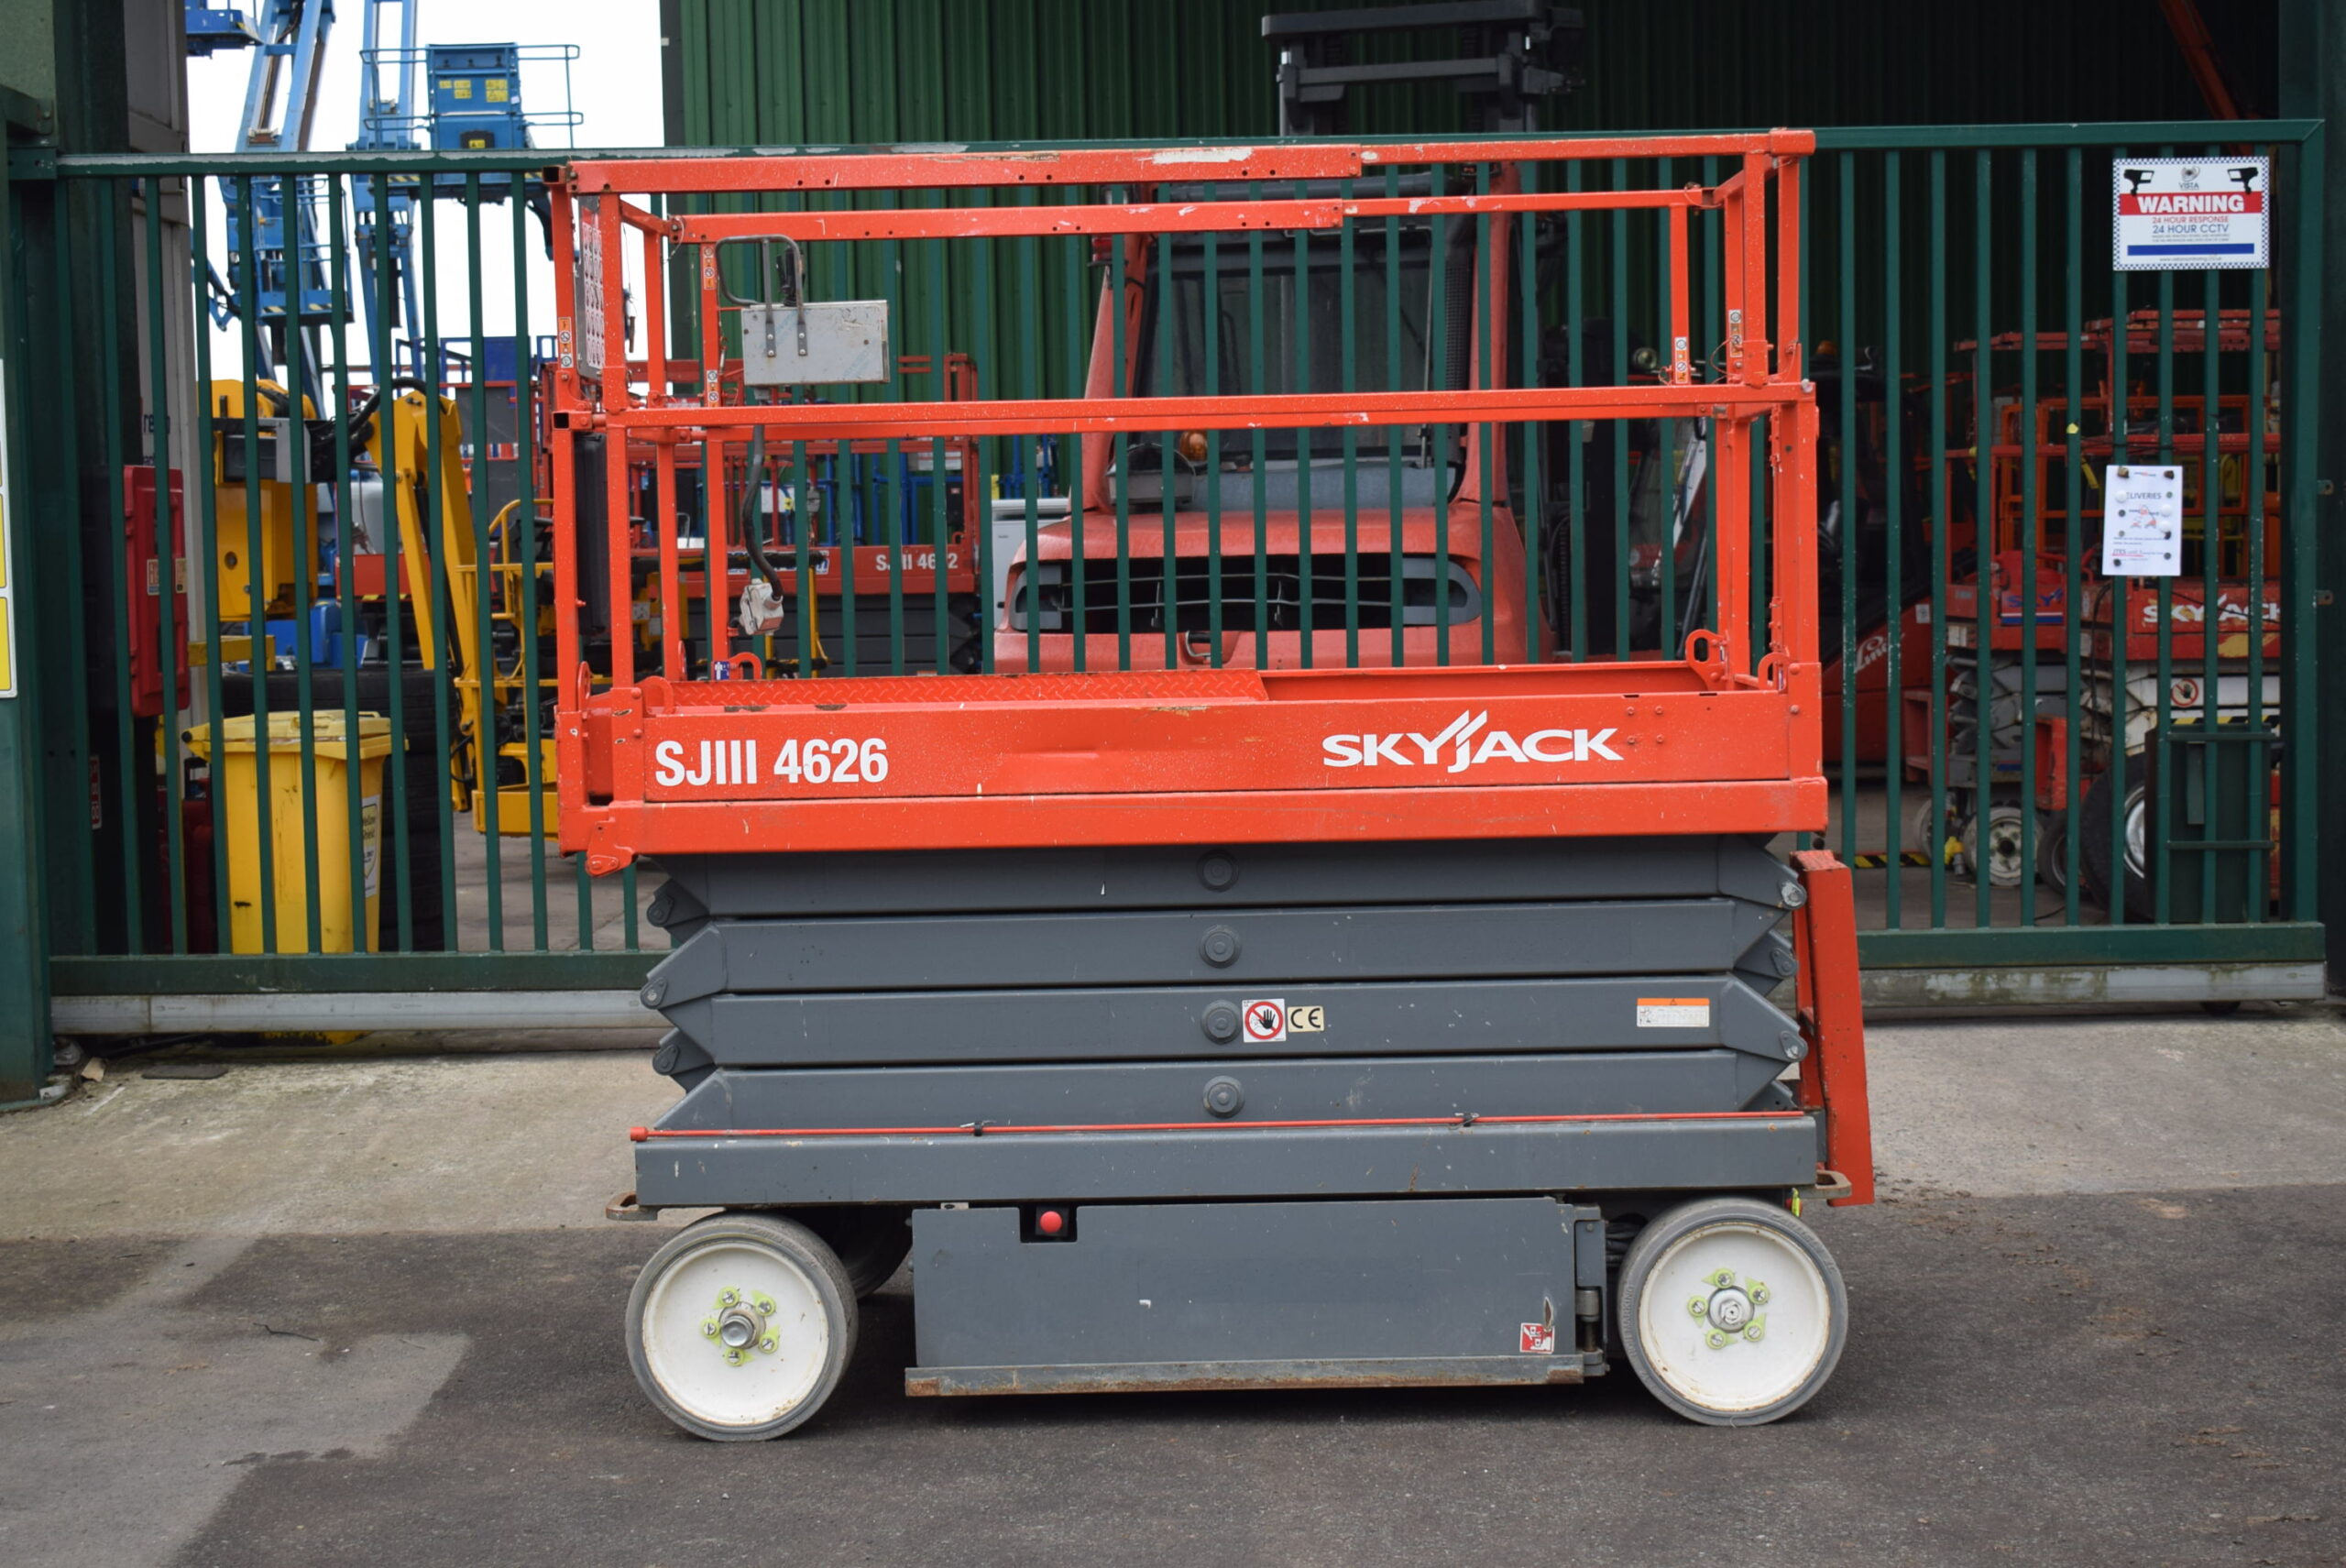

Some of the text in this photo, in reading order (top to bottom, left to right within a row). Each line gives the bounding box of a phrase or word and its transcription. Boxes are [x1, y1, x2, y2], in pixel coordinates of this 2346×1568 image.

[2136, 194, 2244, 214] WARNING
[2152, 224, 2229, 234] 24 HOUR CCTV
[917, 554, 958, 569] 462
[1321, 709, 1625, 773] SKYJACK
[655, 738, 889, 786] SJIII 4626
[1290, 1007, 1321, 1029] CE
